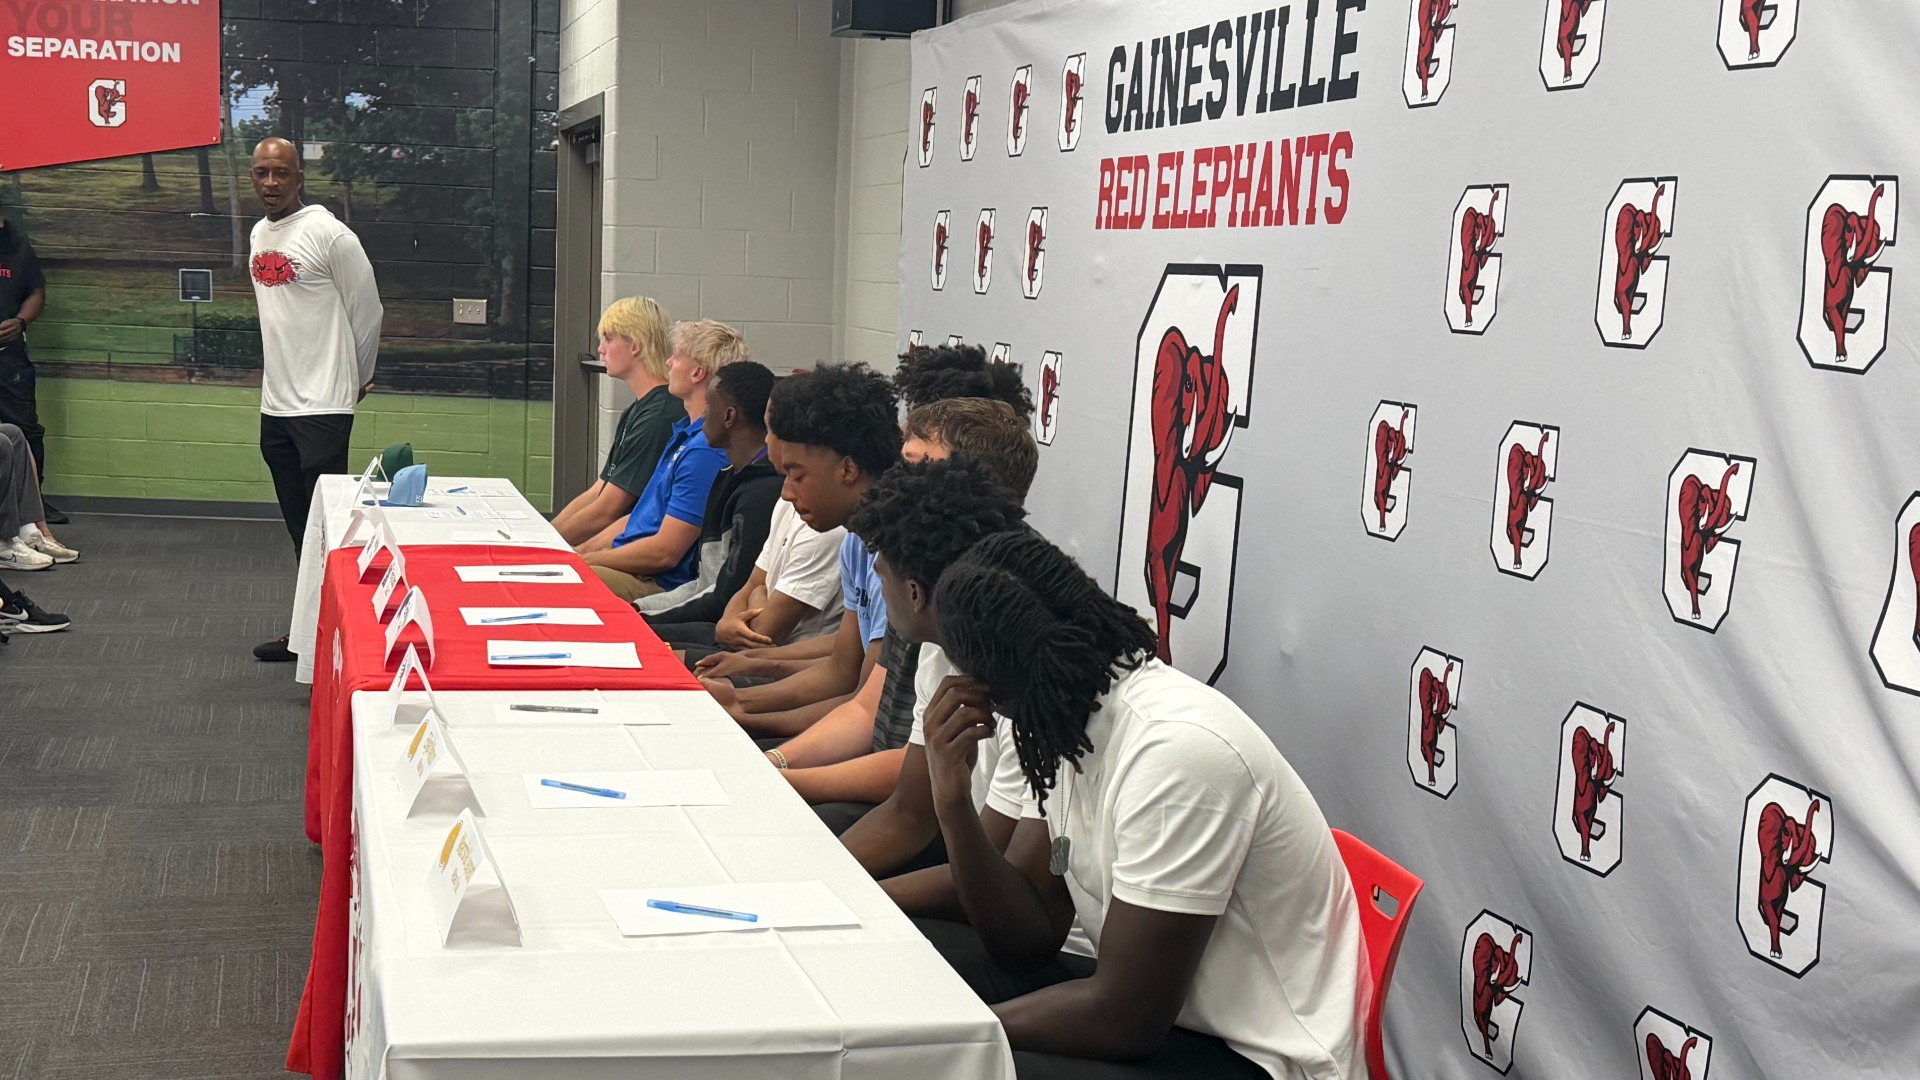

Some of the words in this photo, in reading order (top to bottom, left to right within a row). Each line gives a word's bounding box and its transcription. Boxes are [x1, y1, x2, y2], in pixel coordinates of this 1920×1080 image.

[5, 0, 135, 37] YOUR
[7, 36, 181, 63] SEPARATION
[1105, 0, 1367, 134] GAINESVILLE
[1095, 154, 1150, 229] RED
[1152, 131, 1354, 229] ELEPHANTS
